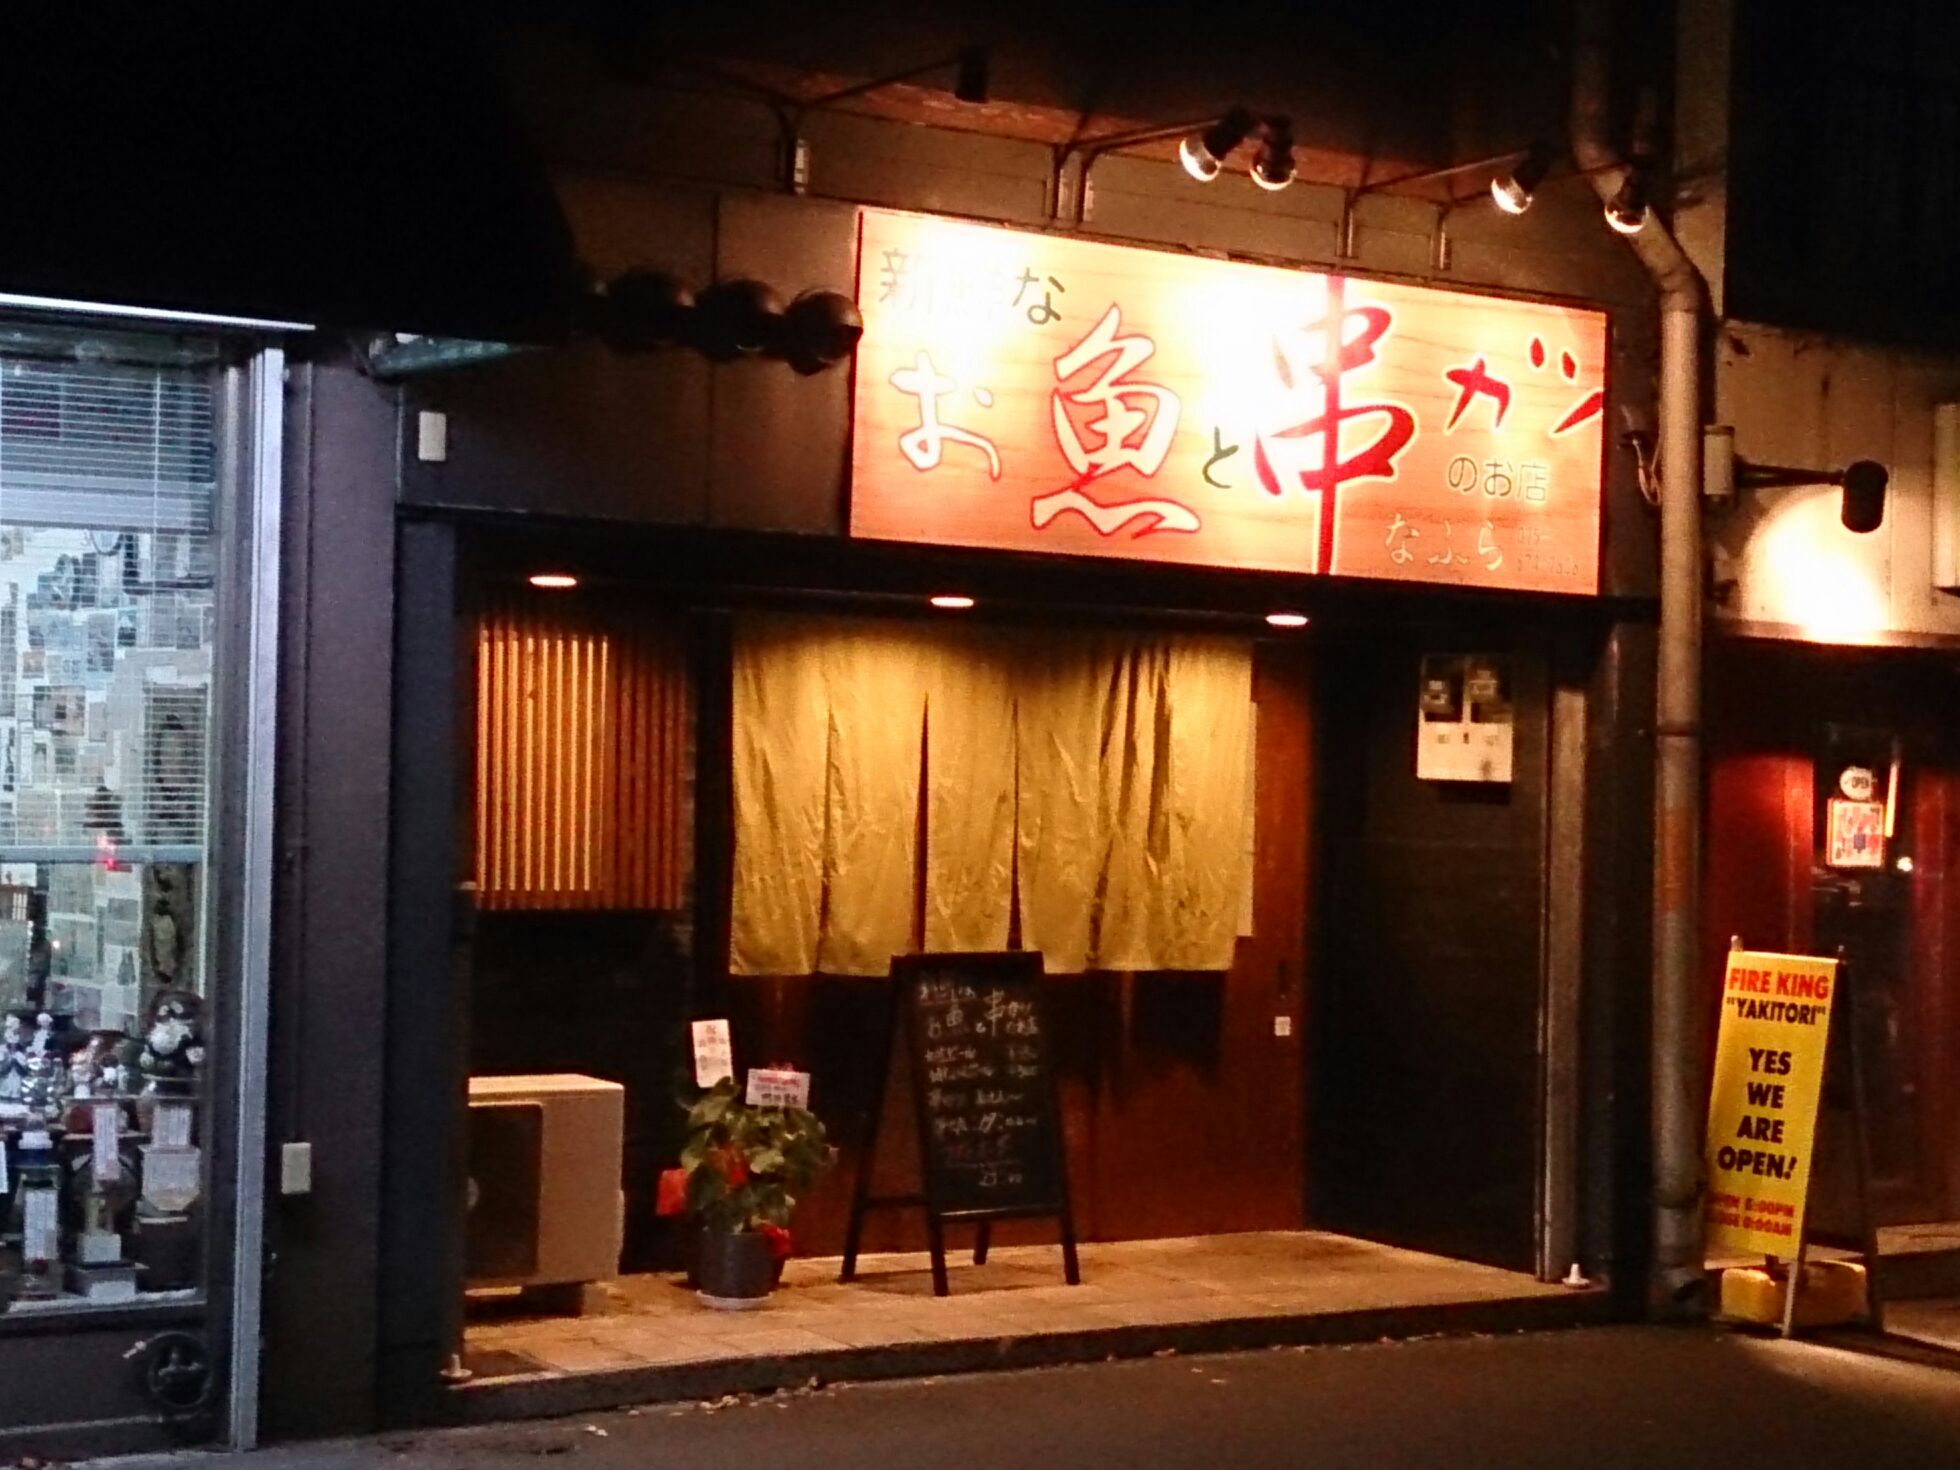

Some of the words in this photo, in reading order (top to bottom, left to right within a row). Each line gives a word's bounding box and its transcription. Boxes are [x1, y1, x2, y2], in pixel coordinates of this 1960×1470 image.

[1448, 456, 1548, 502] のお店
[1729, 968, 1772, 993] FIRE
[1776, 970, 1829, 1000] KING
[1749, 1048, 1791, 1075] YES
[1747, 1082, 1785, 1109] WE
[1737, 1115, 1785, 1144] ARE
[1718, 1146, 1798, 1180] OPEN!
